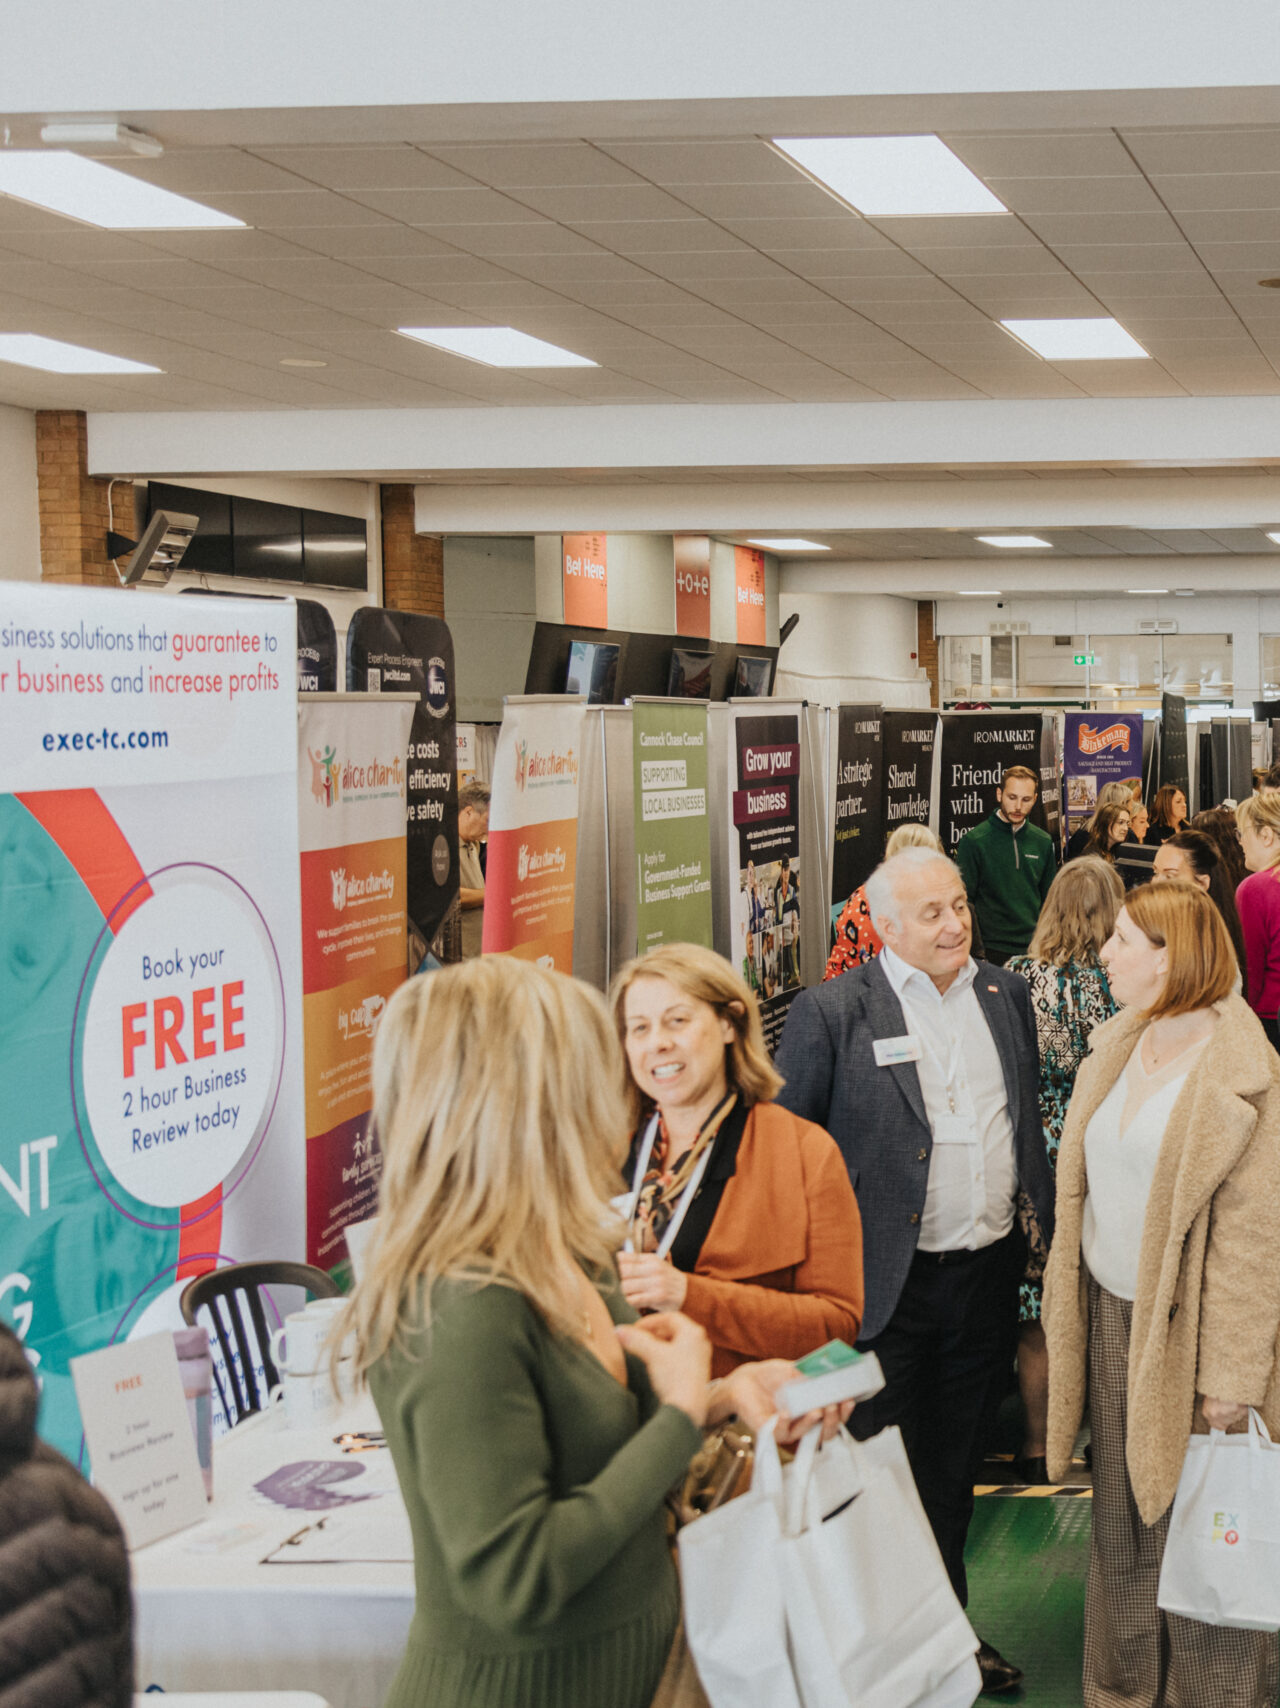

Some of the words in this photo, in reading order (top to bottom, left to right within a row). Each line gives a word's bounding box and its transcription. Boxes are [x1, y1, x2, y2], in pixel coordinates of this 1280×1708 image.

[566, 555, 582, 577] Bet
[583, 558, 605, 580] Here
[737, 586, 749, 604] Bet
[749, 588, 764, 606] Here
[60, 620, 134, 650] solutions
[138, 624, 168, 652] that
[172, 630, 261, 661] guarantee
[265, 632, 278, 652] to
[17, 659, 104, 693] business
[110, 666, 143, 693] and
[149, 665, 223, 693] increase
[229, 661, 280, 700] profits
[42, 728, 169, 752] exec-tc.com
[973, 730, 1035, 743] IRONMARKET
[416, 740, 440, 759] costs
[746, 748, 769, 772] Grow
[770, 751, 792, 775] your
[343, 759, 365, 790] alice
[528, 751, 546, 778] alice
[547, 748, 578, 785] charity
[643, 766, 686, 783] SUPPORTING
[844, 757, 872, 787] strategic
[888, 763, 917, 788] Shared
[409, 769, 451, 792] efficiency
[417, 799, 444, 821] safety
[644, 798, 667, 814] LOCAL
[667, 795, 704, 812] BUSINESSES
[747, 790, 787, 815] business
[887, 793, 930, 822] knowledge
[950, 791, 984, 815] with
[645, 887, 671, 904] Business
[670, 882, 693, 900] Support
[143, 949, 184, 980] Book
[189, 949, 224, 980] your
[121, 980, 246, 1079] FREE
[122, 1092, 133, 1118] 2
[141, 1086, 178, 1113] hour
[184, 1068, 247, 1100] Business
[132, 1120, 190, 1153] Review
[195, 1101, 240, 1133] today
[115, 1374, 143, 1393] FREE
